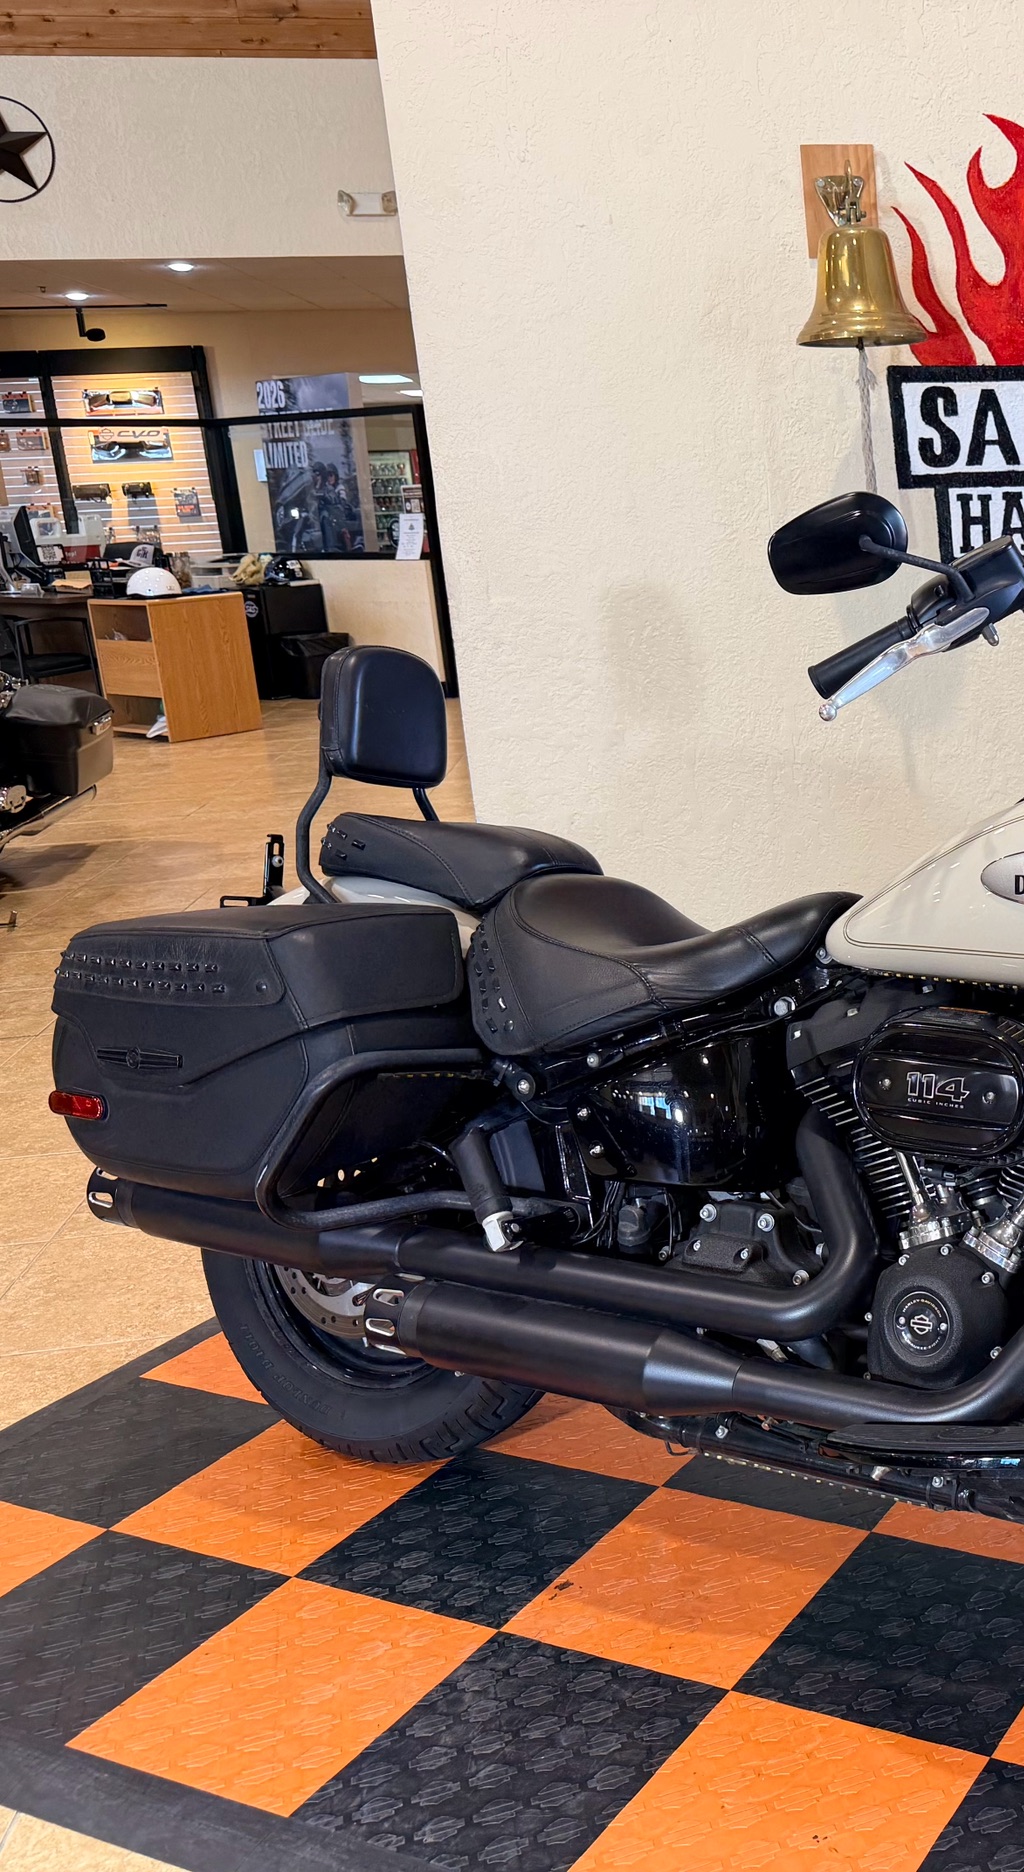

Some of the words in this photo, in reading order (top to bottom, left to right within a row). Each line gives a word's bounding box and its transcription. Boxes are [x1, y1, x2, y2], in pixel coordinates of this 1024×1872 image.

[256, 380, 286, 409] 2026
[117, 430, 161, 439] CVO
[263, 441, 309, 469] LIMITED
[906, 1071, 970, 1103] 114
[935, 1101, 964, 1109] INCHES
